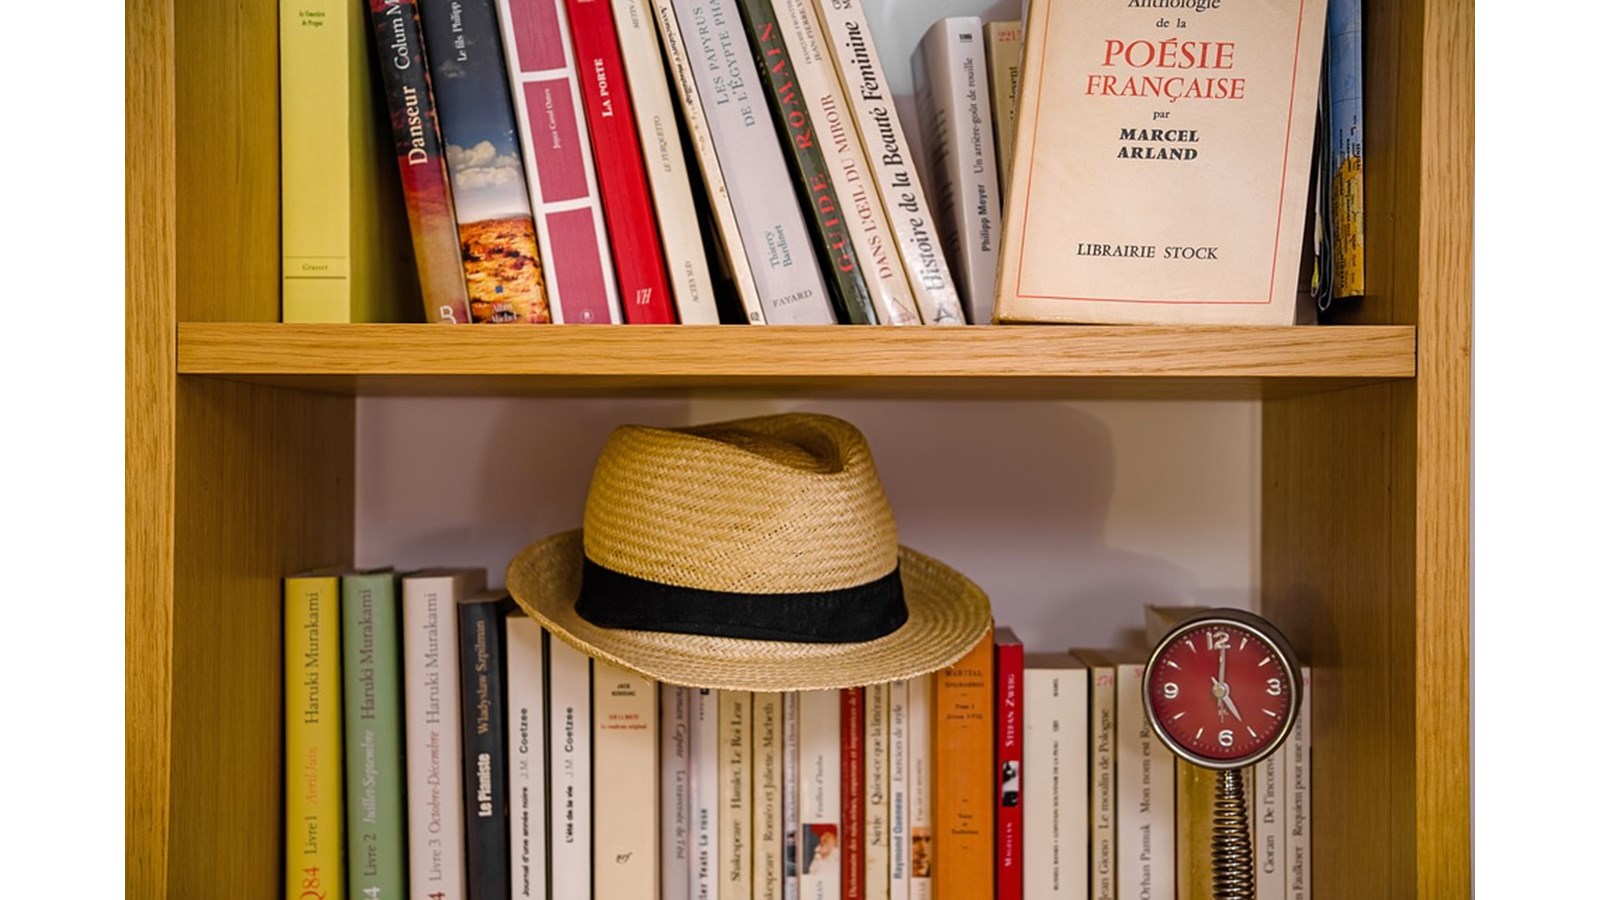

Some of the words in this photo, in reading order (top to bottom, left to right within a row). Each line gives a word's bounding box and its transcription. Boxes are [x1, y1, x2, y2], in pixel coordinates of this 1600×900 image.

[693, 7, 720, 71] PAPYRUS
[1155, 18, 1170, 29] de
[1176, 18, 1187, 29] la
[391, 18, 411, 69] Colum
[454, 35, 466, 49] fils
[457, 50, 468, 61] Le
[1101, 37, 1235, 70] POÉSIE
[719, 31, 748, 101] L'ÉGYPTE
[844, 21, 884, 102] Féminine
[964, 57, 976, 87] rouille
[594, 58, 609, 97] PORTE
[712, 76, 729, 106] LES
[757, 22, 814, 150] ROMAIN
[1084, 74, 1246, 103] FRANÇAISE
[601, 99, 614, 117] LA
[968, 89, 977, 101] de
[402, 85, 428, 165] Danseur
[741, 106, 755, 127] DE
[820, 94, 847, 152] MIROIR
[968, 103, 982, 156] arrière-goût
[1153, 111, 1170, 121] par
[870, 107, 905, 166] Beauté
[1119, 128, 1200, 143] MARCEL
[974, 158, 984, 174] Un
[1116, 146, 1198, 161] ARLAND
[842, 159, 861, 182] DU
[892, 172, 912, 189] la
[853, 185, 878, 232] L'ŒIL
[898, 193, 919, 213] de
[977, 184, 988, 215] Meyer
[810, 173, 855, 272] GUIDE
[979, 217, 991, 251] Philipp
[764, 231, 780, 268] Thierry
[774, 224, 793, 267] Bardinet
[869, 236, 894, 279] DANS
[909, 218, 946, 292] Histoire
[1077, 243, 1156, 258] LIBRAIRIE
[1164, 246, 1219, 260] STOCK
[772, 289, 813, 308] FAYARD
[305, 591, 320, 668] Murakami
[358, 589, 375, 665] Murakami
[423, 592, 440, 668] Murakami
[1206, 632, 1231, 651] 12
[475, 620, 489, 672] Szpilman
[305, 673, 319, 724] Haruki
[361, 667, 376, 720] Haruki
[425, 672, 440, 724] Haruki
[1004, 673, 1016, 708] ZWEIG
[1164, 683, 1179, 699] 9
[1266, 678, 1282, 696] 3
[730, 701, 742, 725] Lear
[762, 703, 774, 747] Macbeth
[893, 704, 905, 725] style
[519, 707, 530, 755] Coetzee
[564, 707, 574, 753] Coetzee
[730, 728, 742, 747] Roi
[893, 727, 903, 738] de
[1004, 711, 1016, 747] STEFAN
[1098, 708, 1112, 753] Pologne
[1218, 730, 1234, 746] 6
[730, 750, 742, 765] Le
[873, 738, 883, 756] que
[893, 740, 903, 782] Exercices
[1098, 755, 1110, 769] de
[1141, 742, 1151, 757] est
[1294, 743, 1303, 764] une
[304, 747, 319, 805] Avril-Juin
[362, 730, 378, 824] Juillet-Septembre
[426, 731, 442, 834] Octobre-Décembre
[477, 753, 492, 801] Pianiste
[1141, 760, 1151, 785] nom
[1294, 765, 1305, 790] pour
[520, 786, 529, 809] noire
[565, 785, 574, 798] vie
[565, 799, 574, 808] la
[763, 790, 774, 801] et
[1098, 772, 1110, 812] moulin
[1140, 788, 1151, 814] Mon
[479, 803, 493, 816] Le
[520, 811, 530, 837] année
[565, 809, 574, 821] de
[699, 808, 708, 831] rose
[762, 803, 774, 842] Roméo
[893, 792, 903, 834] Queneau
[1098, 817, 1110, 830] Le
[1263, 807, 1275, 824] De
[1292, 792, 1306, 837] Requiem
[304, 823, 318, 855] Livre
[364, 833, 376, 842] 2
[429, 838, 441, 846] 3
[565, 823, 574, 843] L'été
[699, 835, 708, 847] La
[871, 815, 882, 846] Sartre
[1139, 823, 1151, 861] Pamuk
[364, 845, 378, 877] Livre
[429, 849, 442, 881] Livre
[520, 838, 530, 863] d'une
[699, 851, 708, 879] Yeats
[731, 819, 744, 882] Shakespeare
[893, 836, 904, 879] Raymond
[1098, 839, 1110, 875] Giono
[1263, 836, 1275, 874] Cioran
[521, 864, 530, 898] Journal
[1140, 864, 1151, 900] Orhan
[1292, 846, 1303, 891] Faulkner
